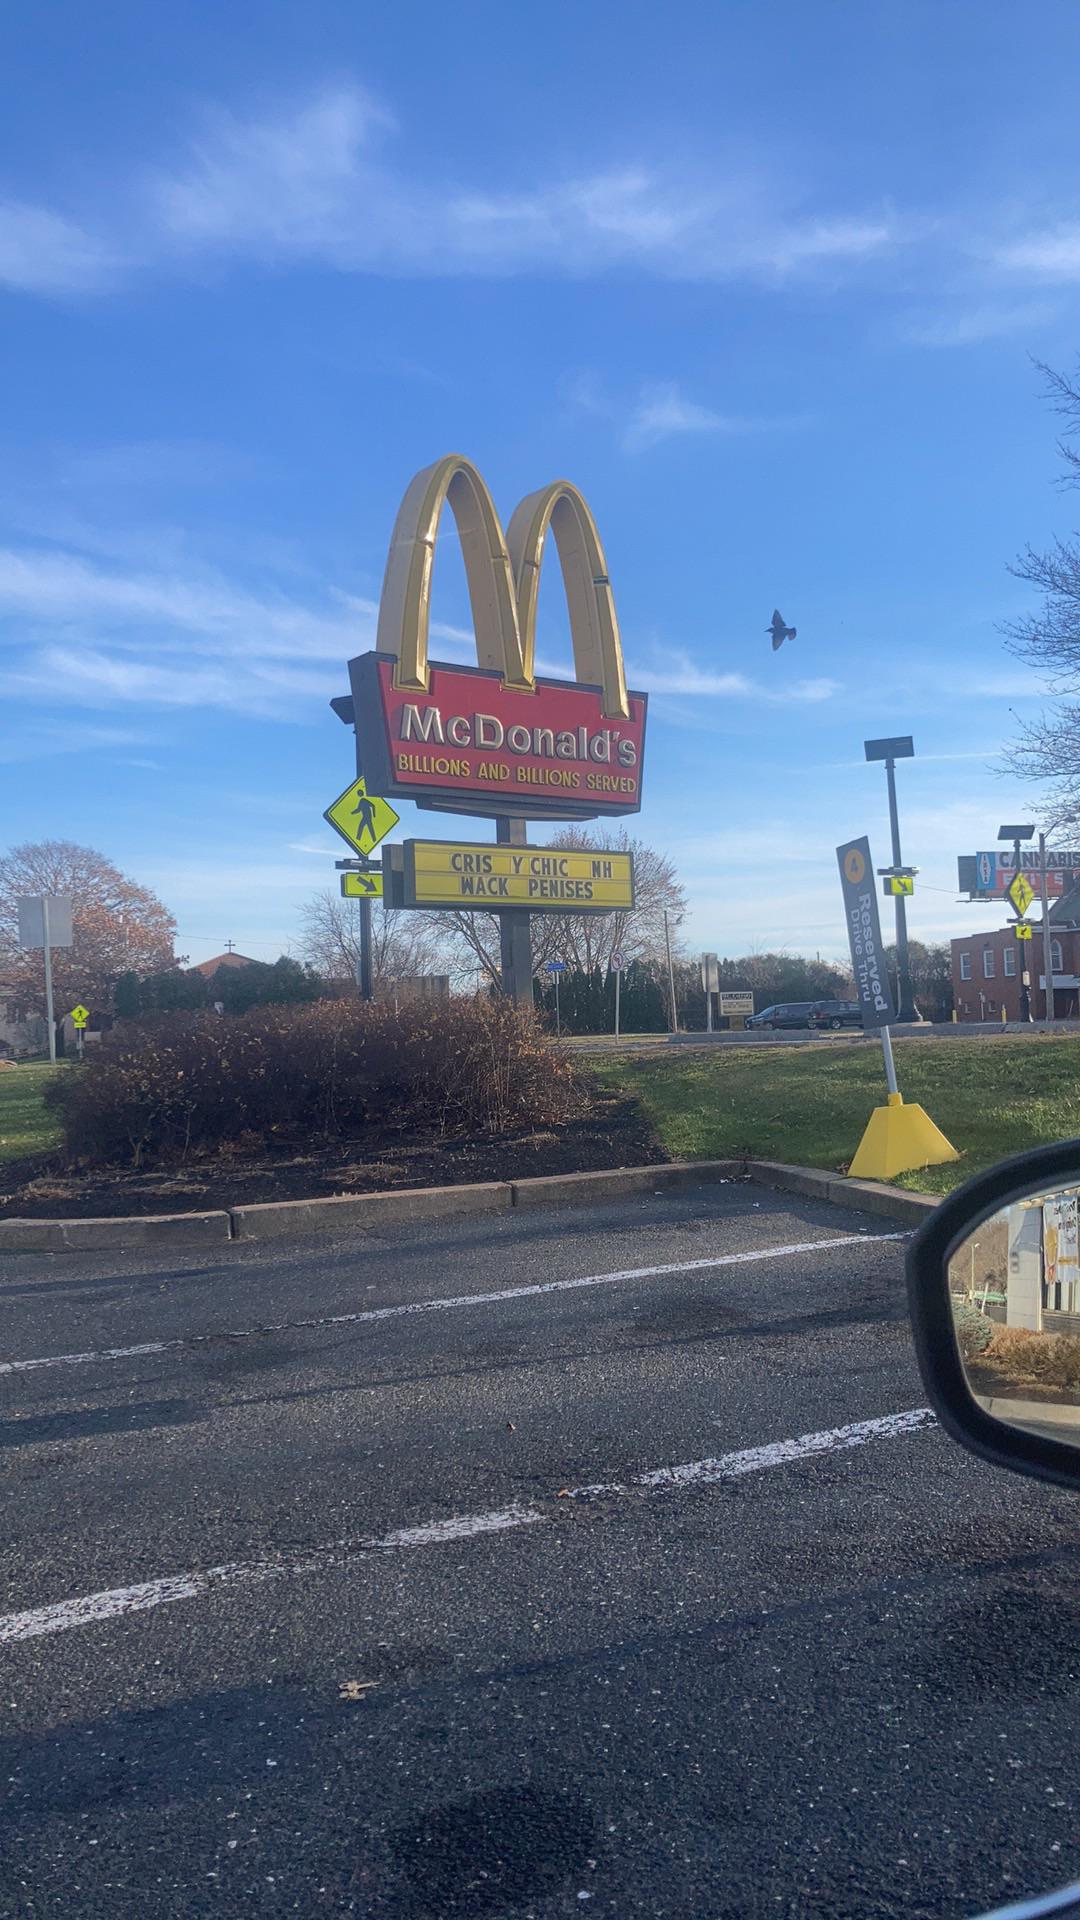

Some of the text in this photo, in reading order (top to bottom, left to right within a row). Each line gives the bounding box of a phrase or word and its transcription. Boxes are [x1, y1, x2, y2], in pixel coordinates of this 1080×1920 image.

[400, 703, 638, 768] McDonald's
[398, 753, 637, 794] BILLIONS AND BILLIONS SERVED
[450, 853, 493, 874] CRIS
[530, 857, 569, 878] CHIC
[591, 860, 612, 879] NH
[460, 876, 594, 900] WACK PENISES
[851, 909, 871, 1002] Drive Thru
[858, 893, 888, 1011] Reserved
